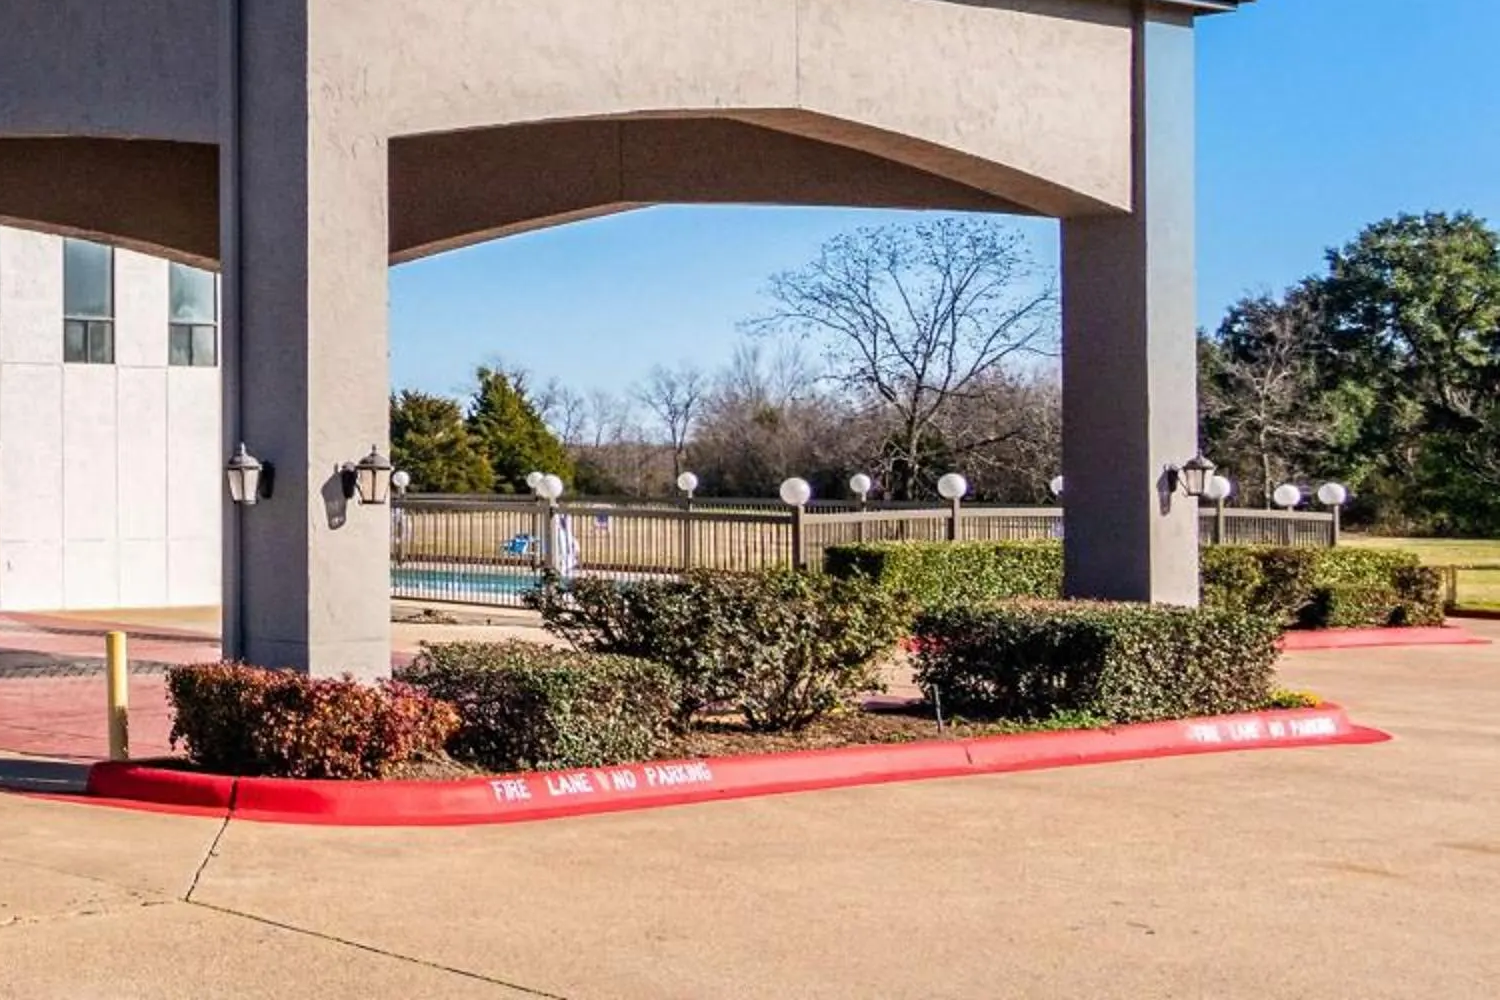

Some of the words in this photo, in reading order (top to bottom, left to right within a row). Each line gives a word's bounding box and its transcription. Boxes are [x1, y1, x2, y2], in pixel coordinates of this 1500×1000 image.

[490, 778, 532, 801] FIRE
[545, 773, 594, 797] LANE
[612, 769, 637, 791] NO
[643, 761, 713, 787] PARKING
